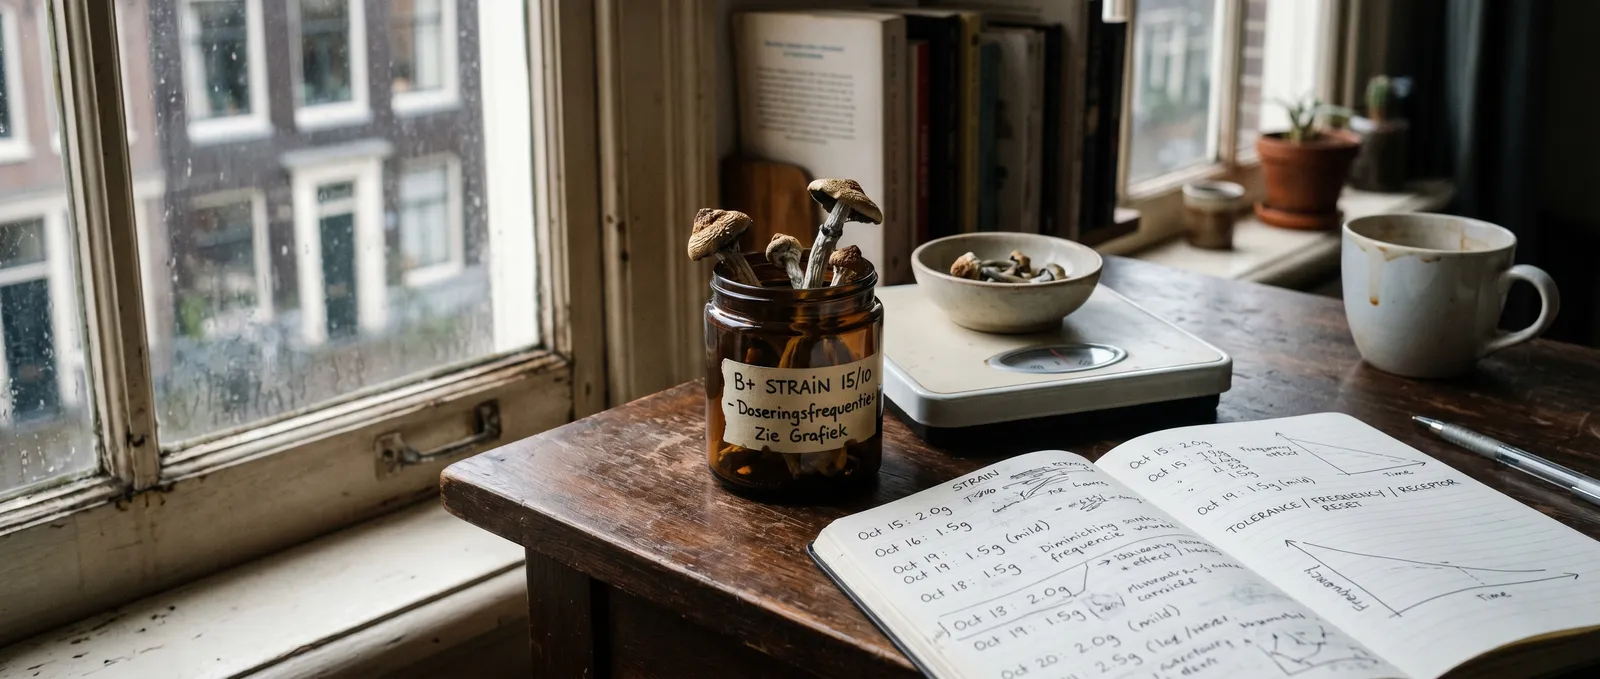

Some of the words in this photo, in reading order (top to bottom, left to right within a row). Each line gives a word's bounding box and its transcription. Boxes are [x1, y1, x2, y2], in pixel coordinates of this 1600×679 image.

[734, 372, 755, 391] B+
[841, 366, 872, 390] 15/10
[755, 426, 781, 442] Zie
[789, 423, 848, 445] Grafiek
[1129, 455, 1151, 470] Oct
[1179, 440, 1213, 449] 2.0g
[952, 469, 1000, 492] STRAIN
[1148, 468, 1169, 482] Oct
[1228, 470, 1259, 478] 1.5g
[1382, 469, 1414, 477] Time
[1197, 500, 1220, 516] Oct
[1247, 481, 1282, 493] 1.5g
[1278, 476, 1316, 490] (mild)
[1225, 501, 1302, 534] TOLERANCE
[1311, 489, 1386, 504] FREQUENCY
[1398, 478, 1461, 494] RECEPTOR
[1321, 501, 1363, 512] RESET
[858, 527, 882, 541] Oct
[915, 506, 953, 521] 2.0g
[875, 543, 900, 558] Oct
[936, 521, 973, 536] 1.5g
[903, 570, 928, 585] Oct
[965, 543, 1006, 560] 1.5g
[1005, 519, 1050, 544] (mild)
[1051, 532, 1125, 563] frequencie
[893, 561, 918, 575] Oct
[920, 588, 945, 603] Oct
[983, 563, 1022, 579] 1.5g
[954, 614, 983, 631] Oct
[1027, 586, 1073, 605] 2.0g
[974, 636, 1001, 651] Oct
[1046, 609, 1087, 625] 1.5g
[1001, 663, 1029, 679] Oct
[1074, 634, 1121, 654] 2.0g
[1128, 604, 1181, 633] (mild)
[1095, 653, 1143, 673] 2.5g
